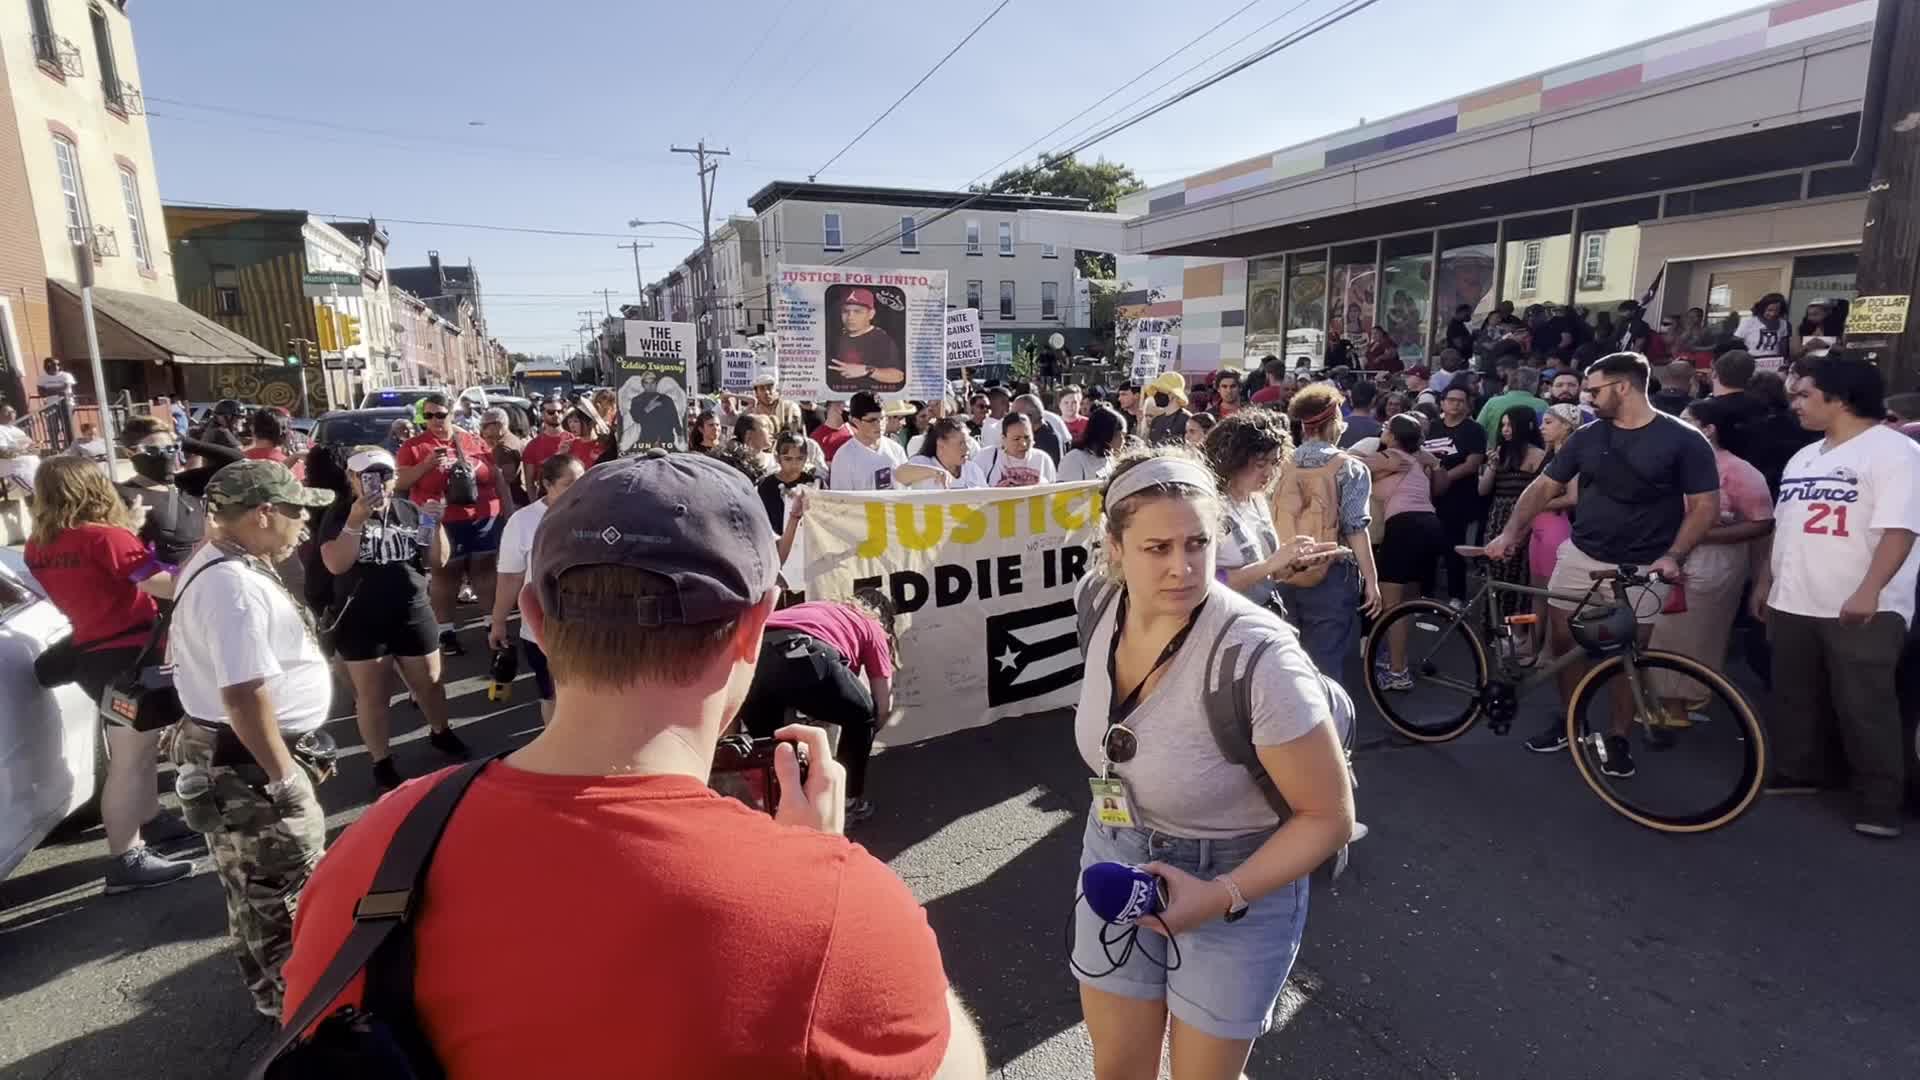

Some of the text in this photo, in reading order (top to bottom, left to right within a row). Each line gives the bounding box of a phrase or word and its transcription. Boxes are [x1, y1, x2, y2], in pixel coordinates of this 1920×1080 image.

[782, 271, 929, 286] JUSTICE FOR JUNITO
[1868, 297, 1907, 307] DOLLAR
[1849, 313, 1904, 323] JUNK CARS
[649, 327, 671, 339] THE
[947, 324, 974, 335] GAINST
[640, 338, 682, 352] WHOLE
[947, 340, 973, 350] POLICE
[1804, 503, 1849, 537] 21
